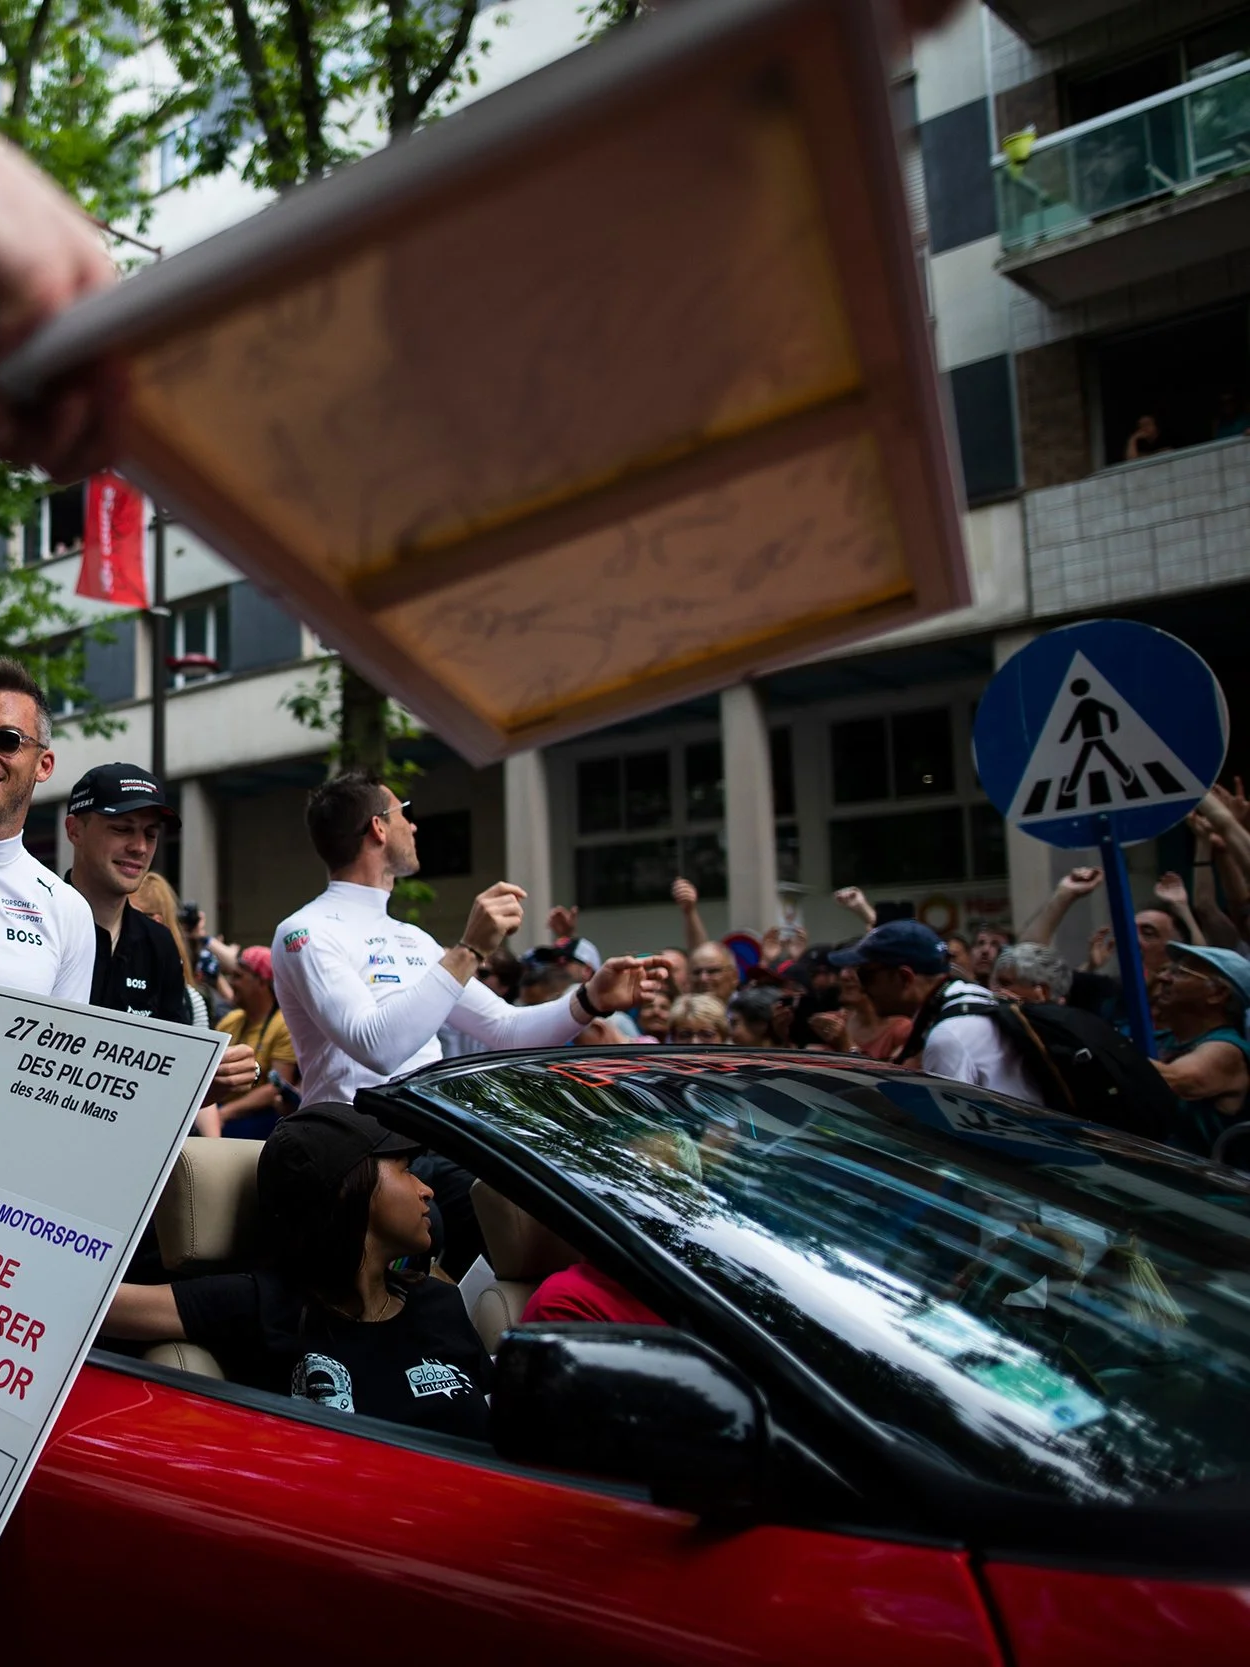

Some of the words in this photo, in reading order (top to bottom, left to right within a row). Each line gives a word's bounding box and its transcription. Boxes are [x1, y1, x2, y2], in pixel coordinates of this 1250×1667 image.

[6, 928, 43, 946] BOSS
[126, 977, 147, 990] BOSS
[4, 1016, 40, 1041] 27
[37, 1022, 87, 1055] ème
[92, 1040, 176, 1076] PARADE
[17, 1053, 57, 1079] DES
[56, 1063, 139, 1101] PILOTES
[10, 1080, 34, 1098] des
[34, 1087, 59, 1106] 24h
[61, 1094, 80, 1112] du
[80, 1099, 119, 1123] Mans
